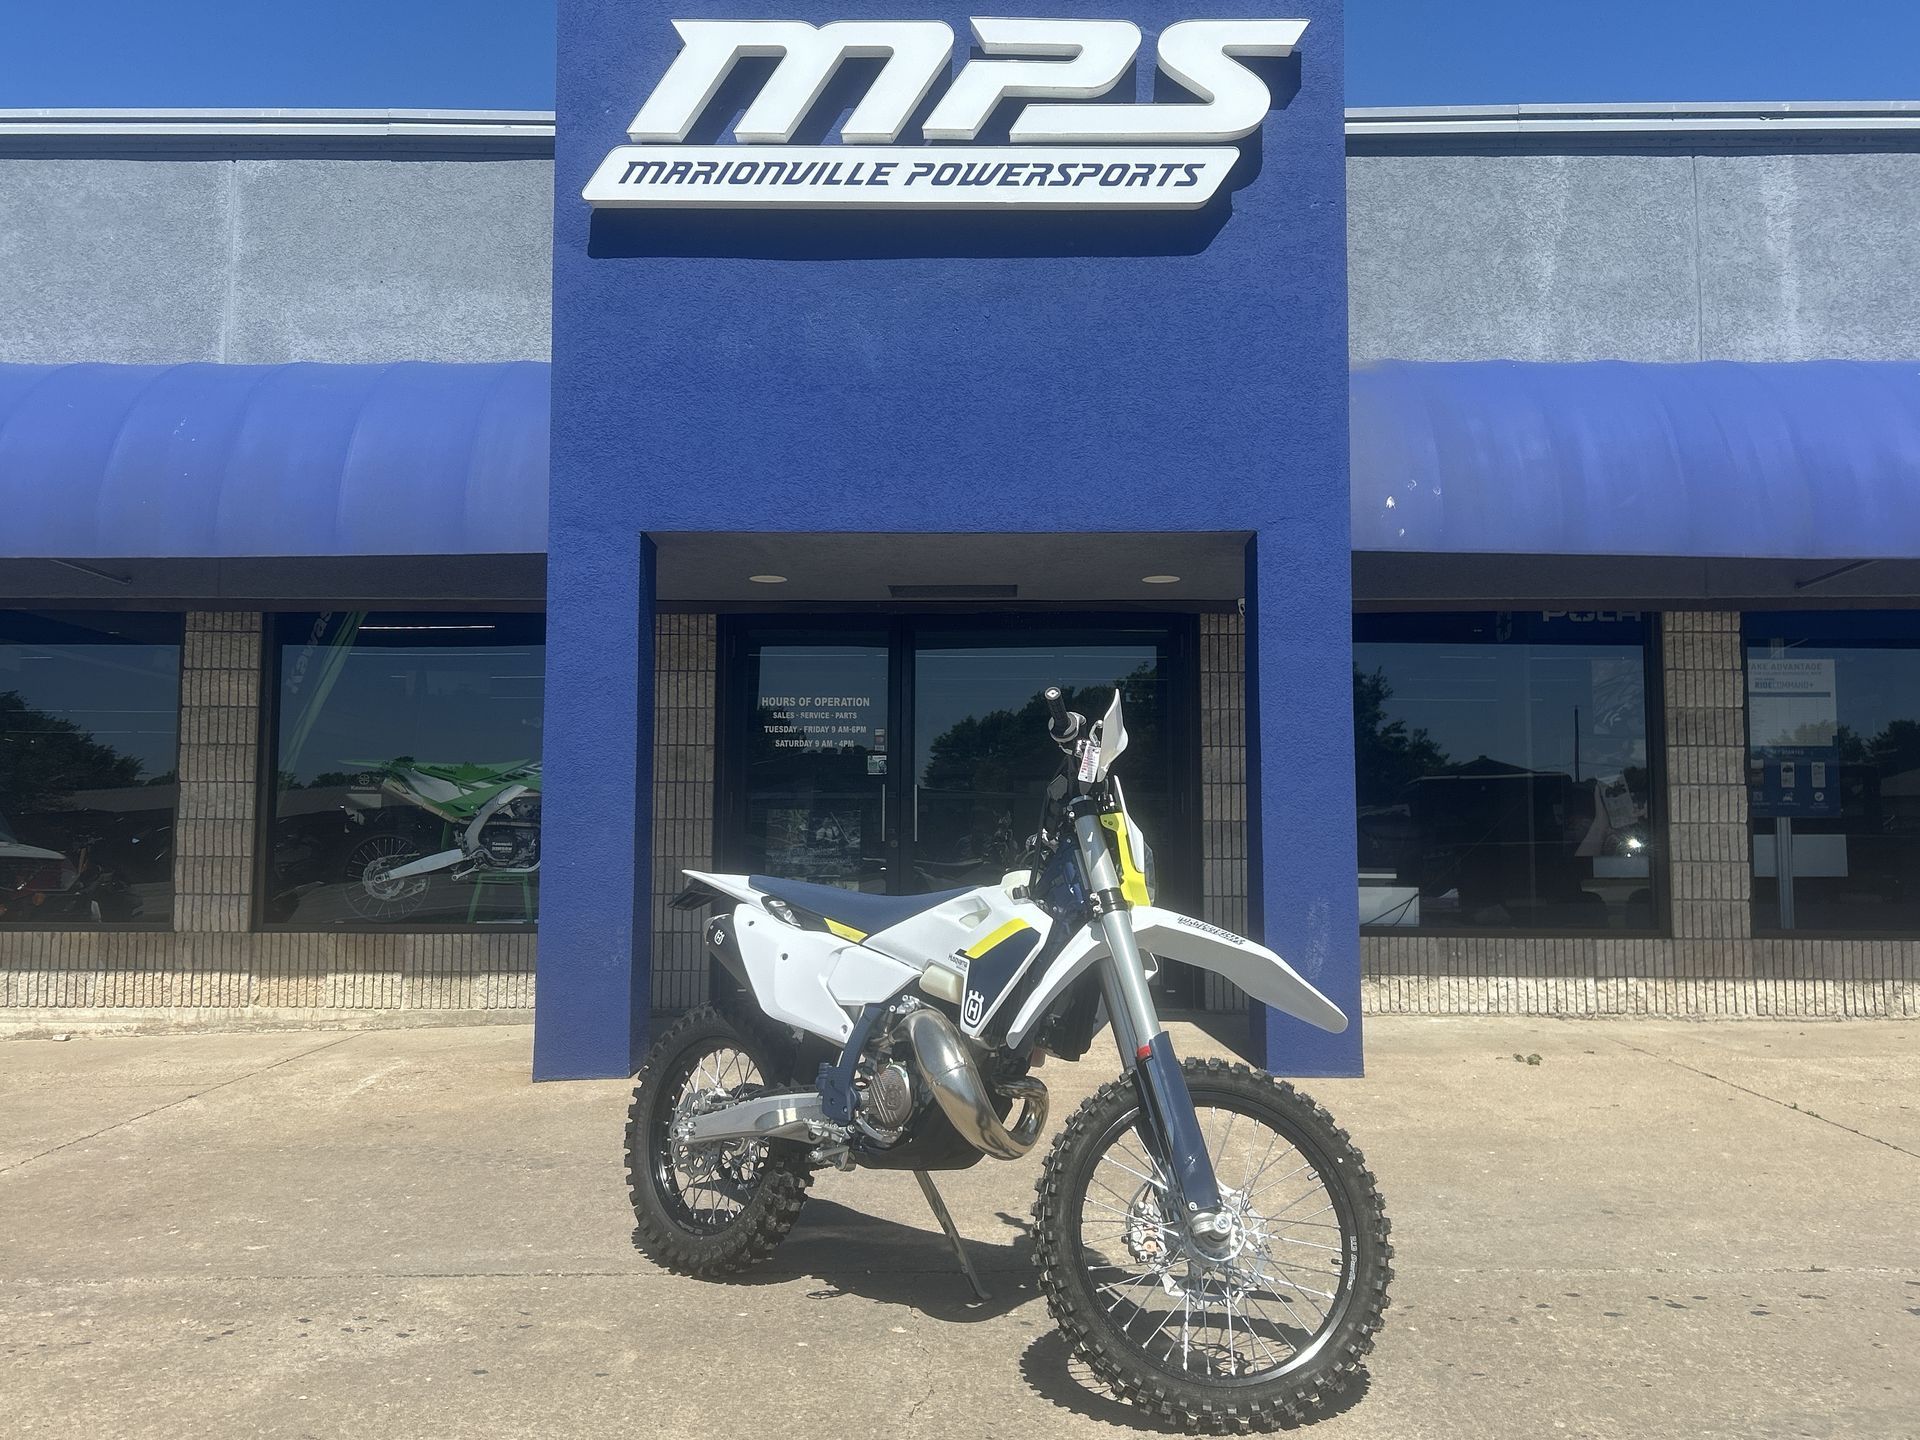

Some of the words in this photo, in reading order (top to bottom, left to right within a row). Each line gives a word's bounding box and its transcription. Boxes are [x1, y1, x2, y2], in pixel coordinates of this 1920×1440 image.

[626, 17, 1311, 143] MPS
[617, 160, 899, 188] MARIONVILLE
[904, 161, 1206, 188] POWERSPORTS
[761, 697, 796, 707] HOURS
[798, 697, 812, 707] OF
[814, 697, 870, 707] OPERATION
